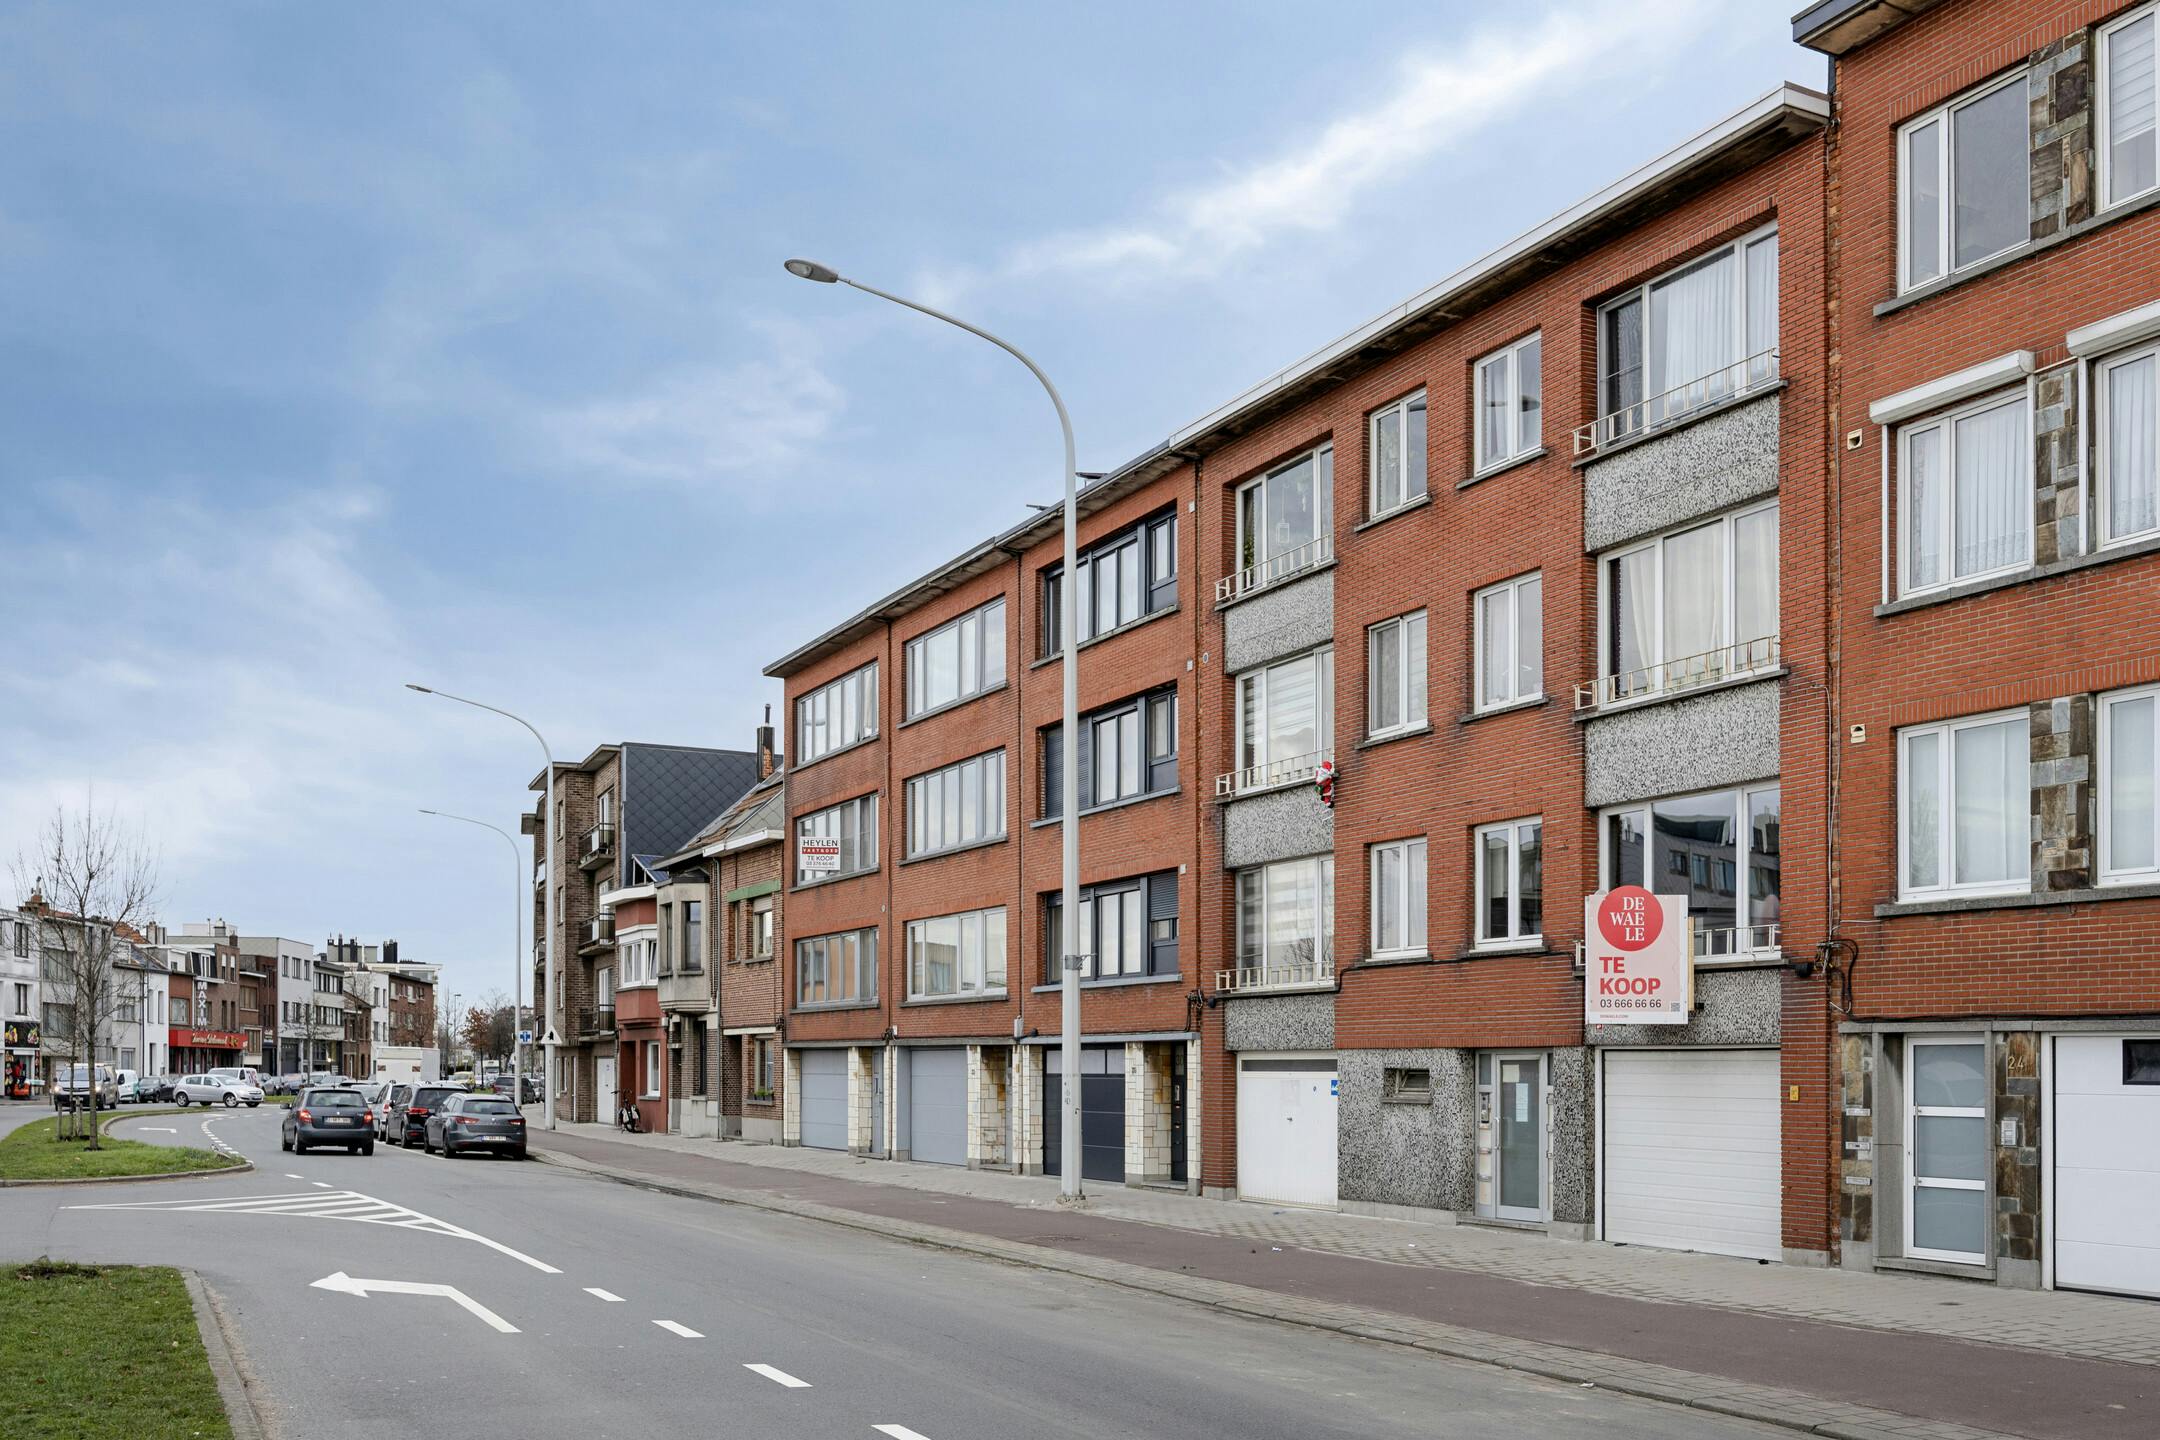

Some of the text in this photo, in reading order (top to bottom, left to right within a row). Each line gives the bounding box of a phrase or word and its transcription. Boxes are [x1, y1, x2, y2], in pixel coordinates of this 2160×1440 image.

[1622, 896, 1645, 911] DE
[1609, 911, 1645, 926] WAE
[1625, 927, 1645, 942] LE
[1599, 956, 1625, 974] TE
[1600, 977, 1661, 995] KOOP
[197, 981, 207, 1026] MAXIM
[1600, 999, 1662, 1008] 03 666 66 66
[2008, 1056, 2024, 1069] 24
